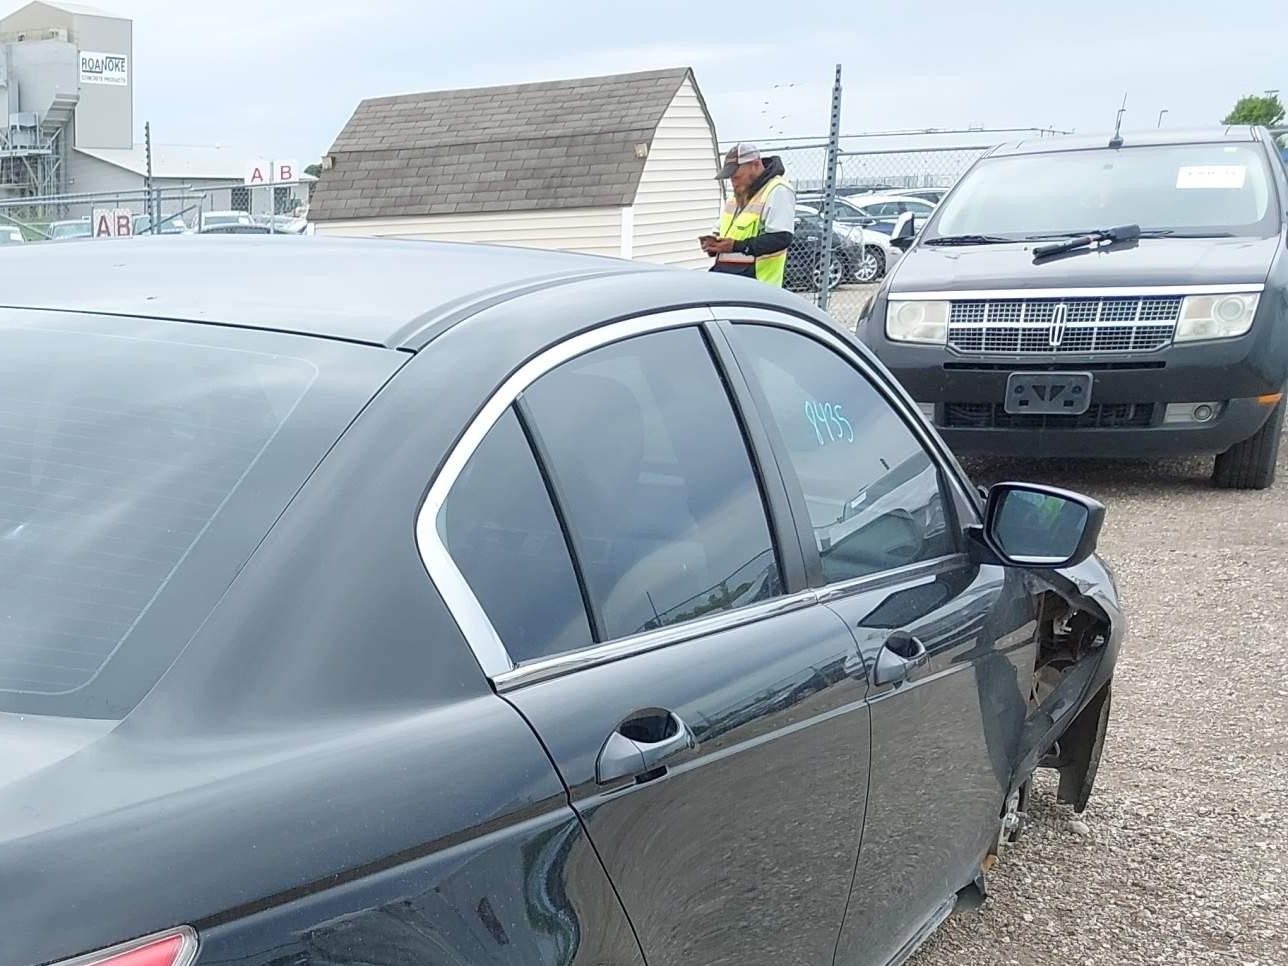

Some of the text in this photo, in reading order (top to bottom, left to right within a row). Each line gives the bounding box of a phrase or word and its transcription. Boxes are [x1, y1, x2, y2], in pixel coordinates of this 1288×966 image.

[81, 56, 126, 73] ROANOKE
[251, 165, 292, 182] A B
[97, 215, 130, 237] A B
